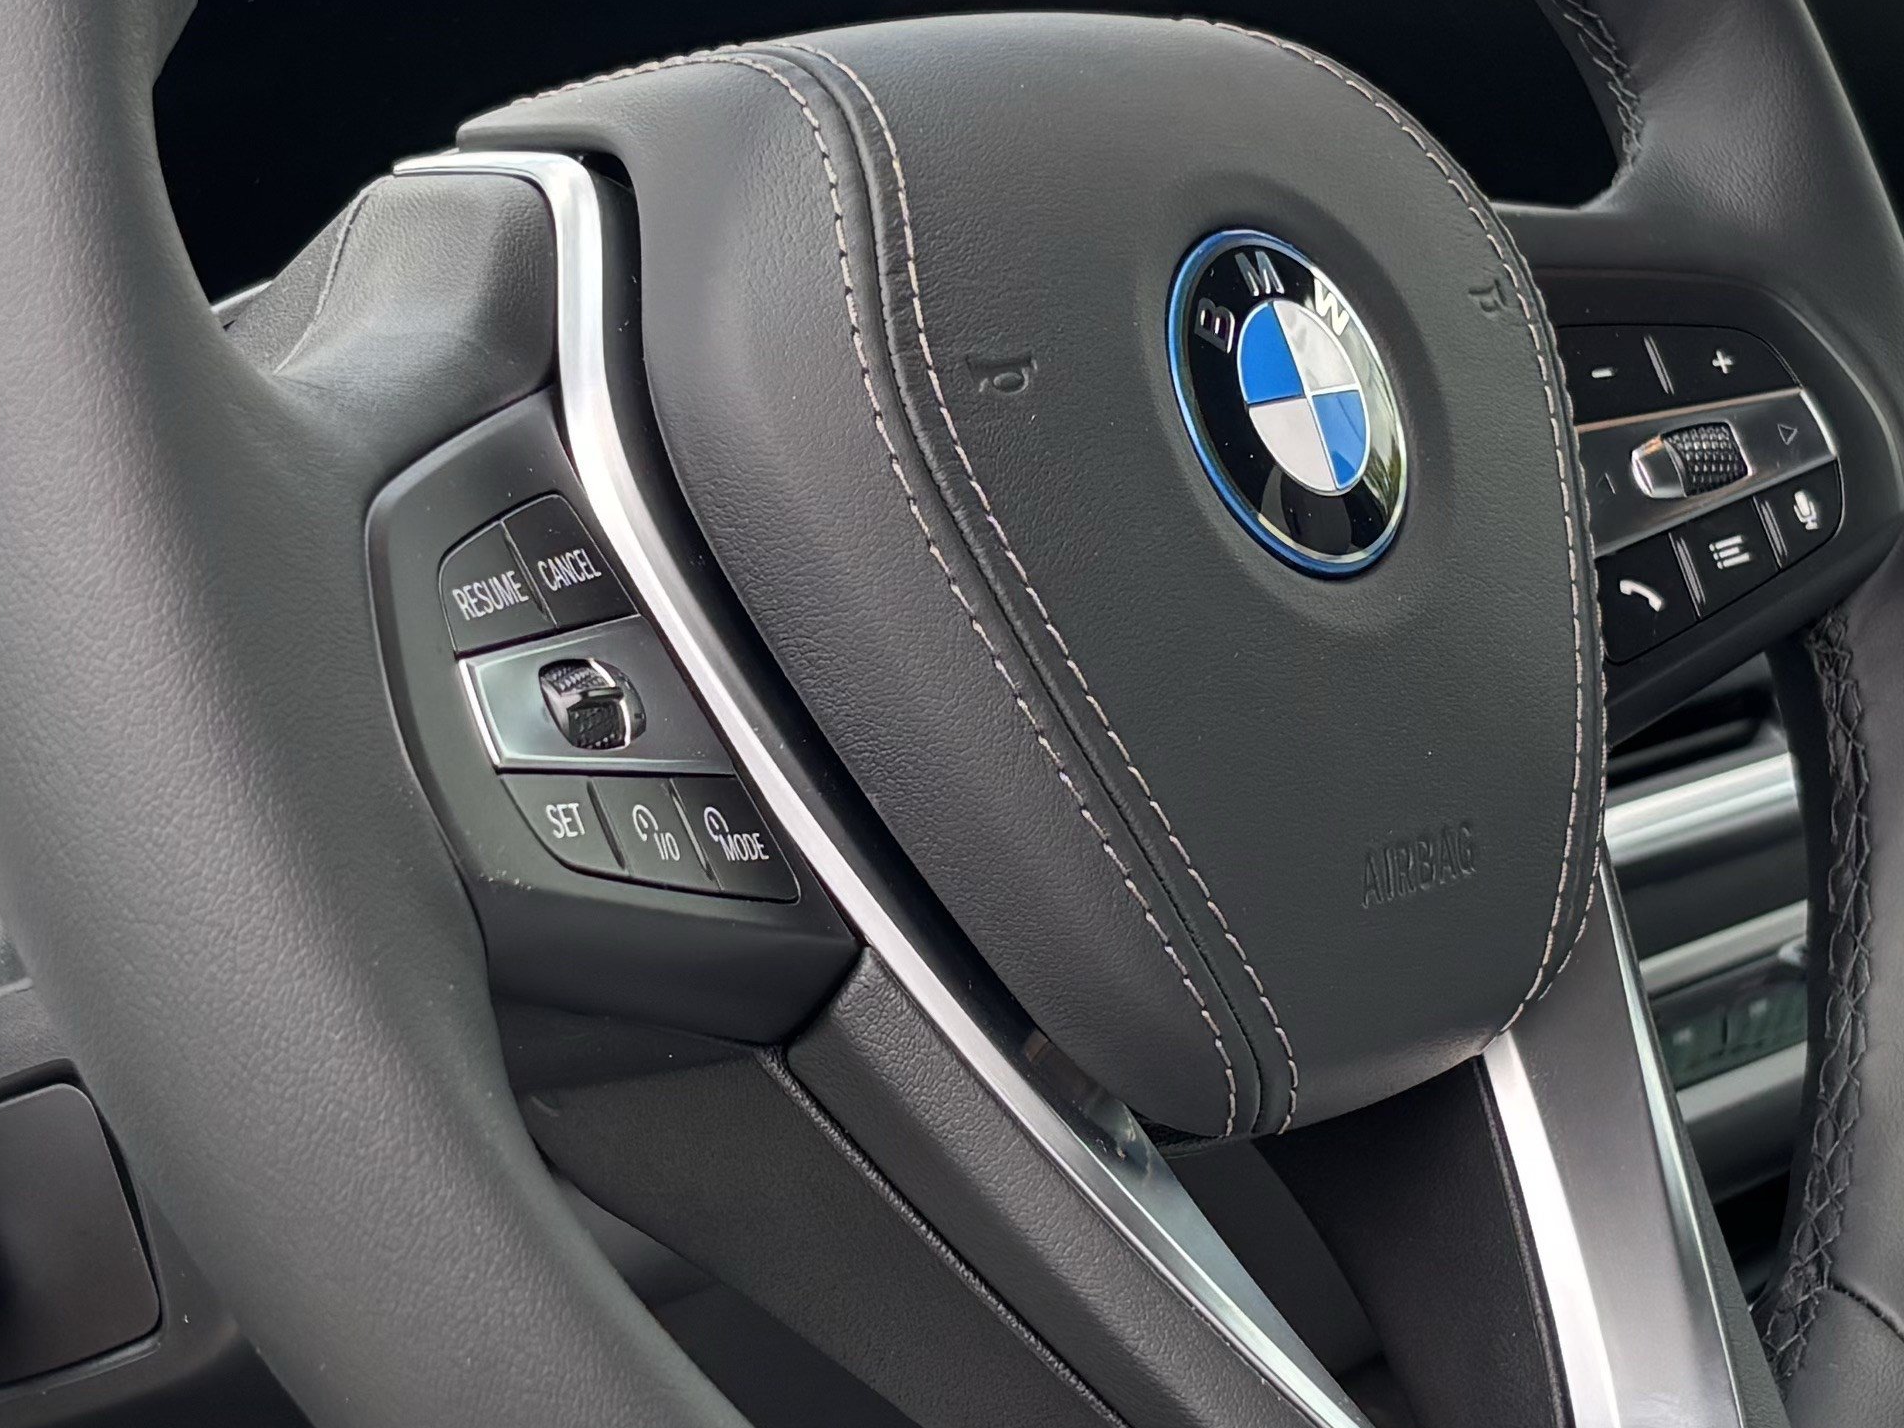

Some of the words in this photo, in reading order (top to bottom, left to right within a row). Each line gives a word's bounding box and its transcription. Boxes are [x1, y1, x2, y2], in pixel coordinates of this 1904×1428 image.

[1194, 250, 1352, 354] BMW
[537, 548, 601, 592] CANCEL
[452, 570, 529, 620] RESUME
[546, 802, 586, 839] SET
[722, 832, 769, 862] MODE
[1361, 821, 1478, 909] AIRBAG
